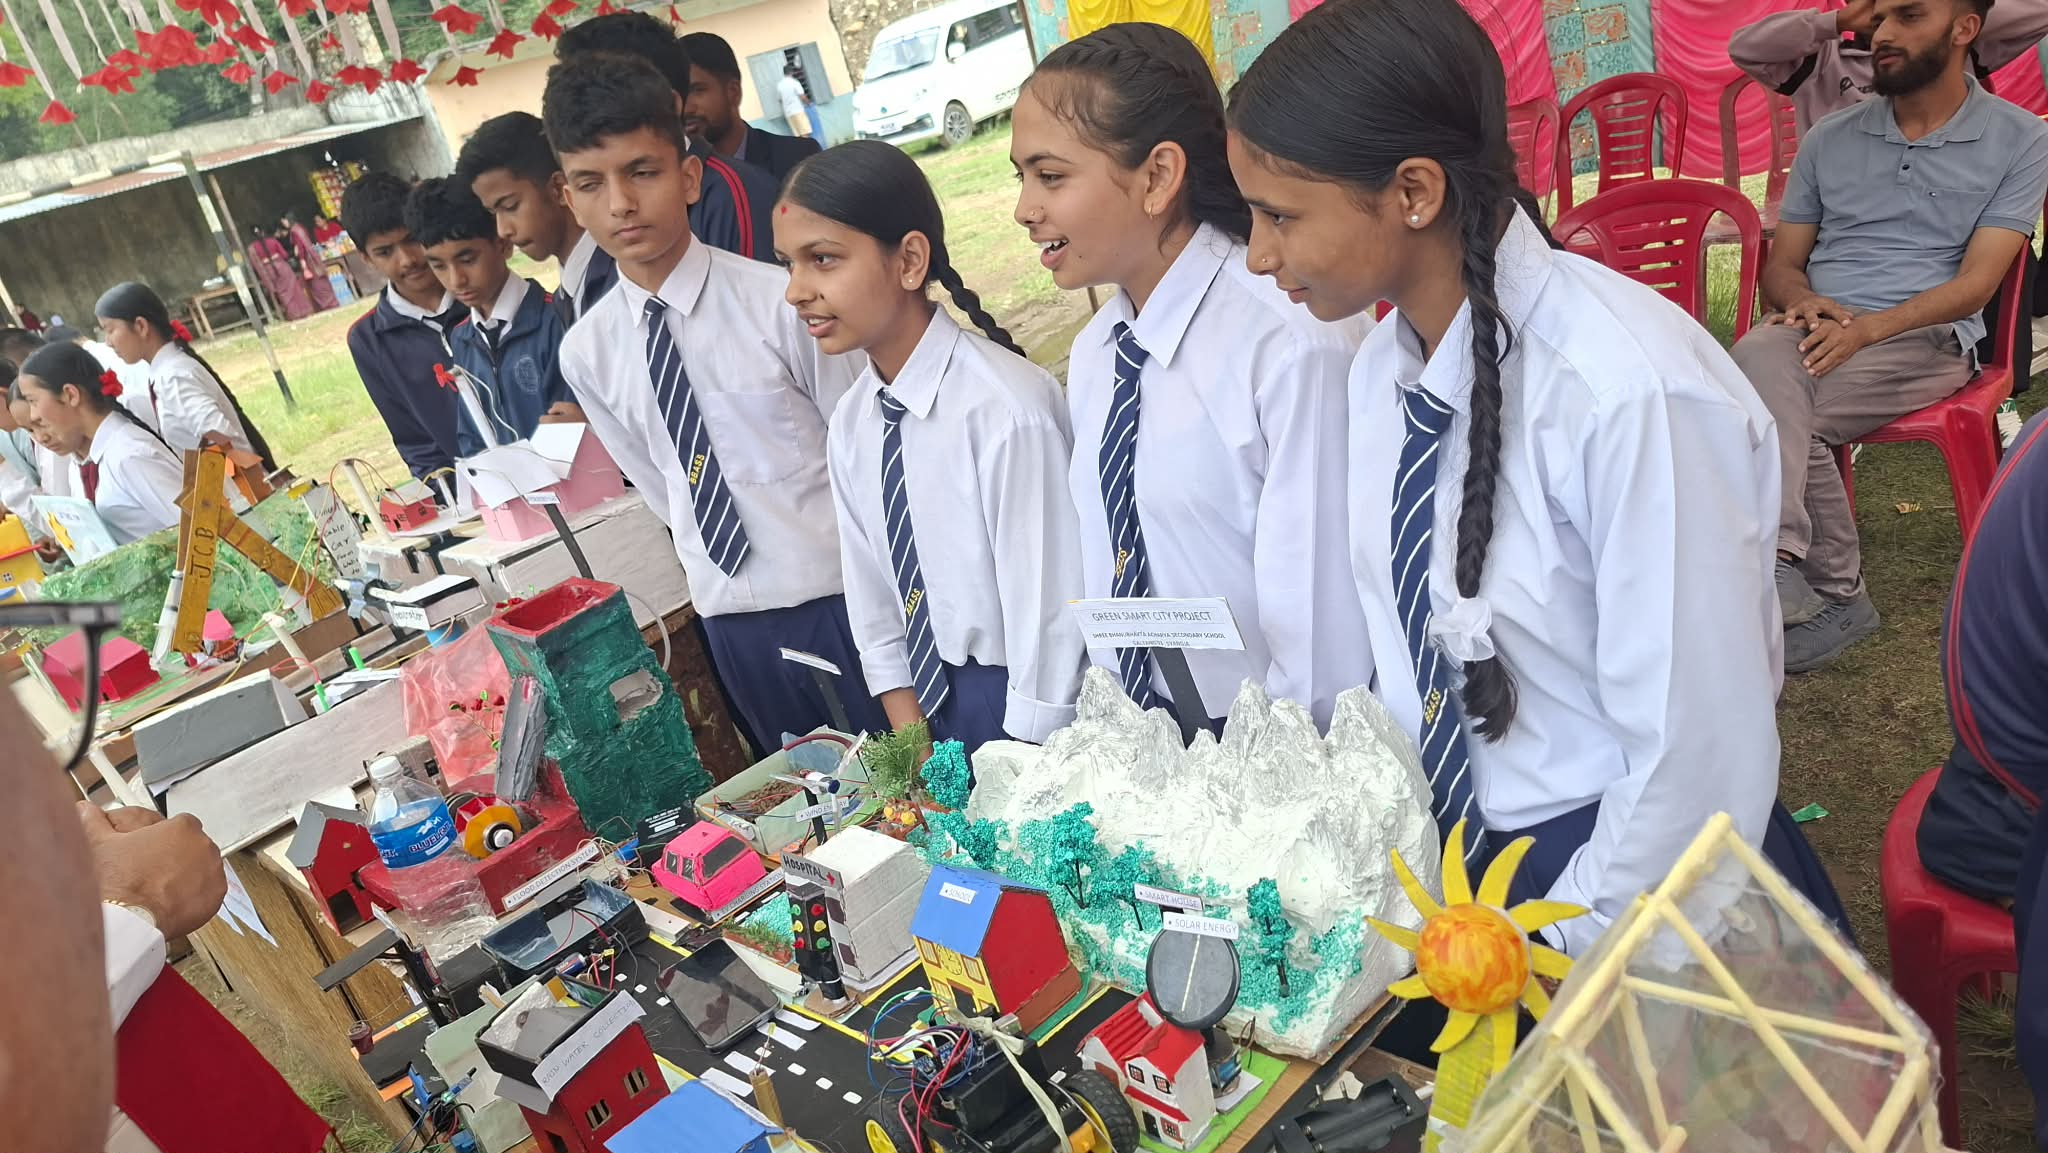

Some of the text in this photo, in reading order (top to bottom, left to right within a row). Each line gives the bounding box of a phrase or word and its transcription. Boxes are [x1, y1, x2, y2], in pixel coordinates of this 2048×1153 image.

[690, 454, 705, 485] BBASS
[190, 527, 216, 579] JCB
[1092, 611, 1213, 622] GREEN SMART CITY PROJECT
[805, 807, 823, 817] WIND
[512, 847, 595, 902] FLOOD DETECTION SYSTEM
[783, 855, 828, 881] HOSPITAL
[1144, 891, 1199, 908] SMART HOUSE
[1175, 919, 1237, 934] SOLAR ENERGY
[542, 1065, 560, 1085] RAIN
[562, 1041, 590, 1067] WATER
